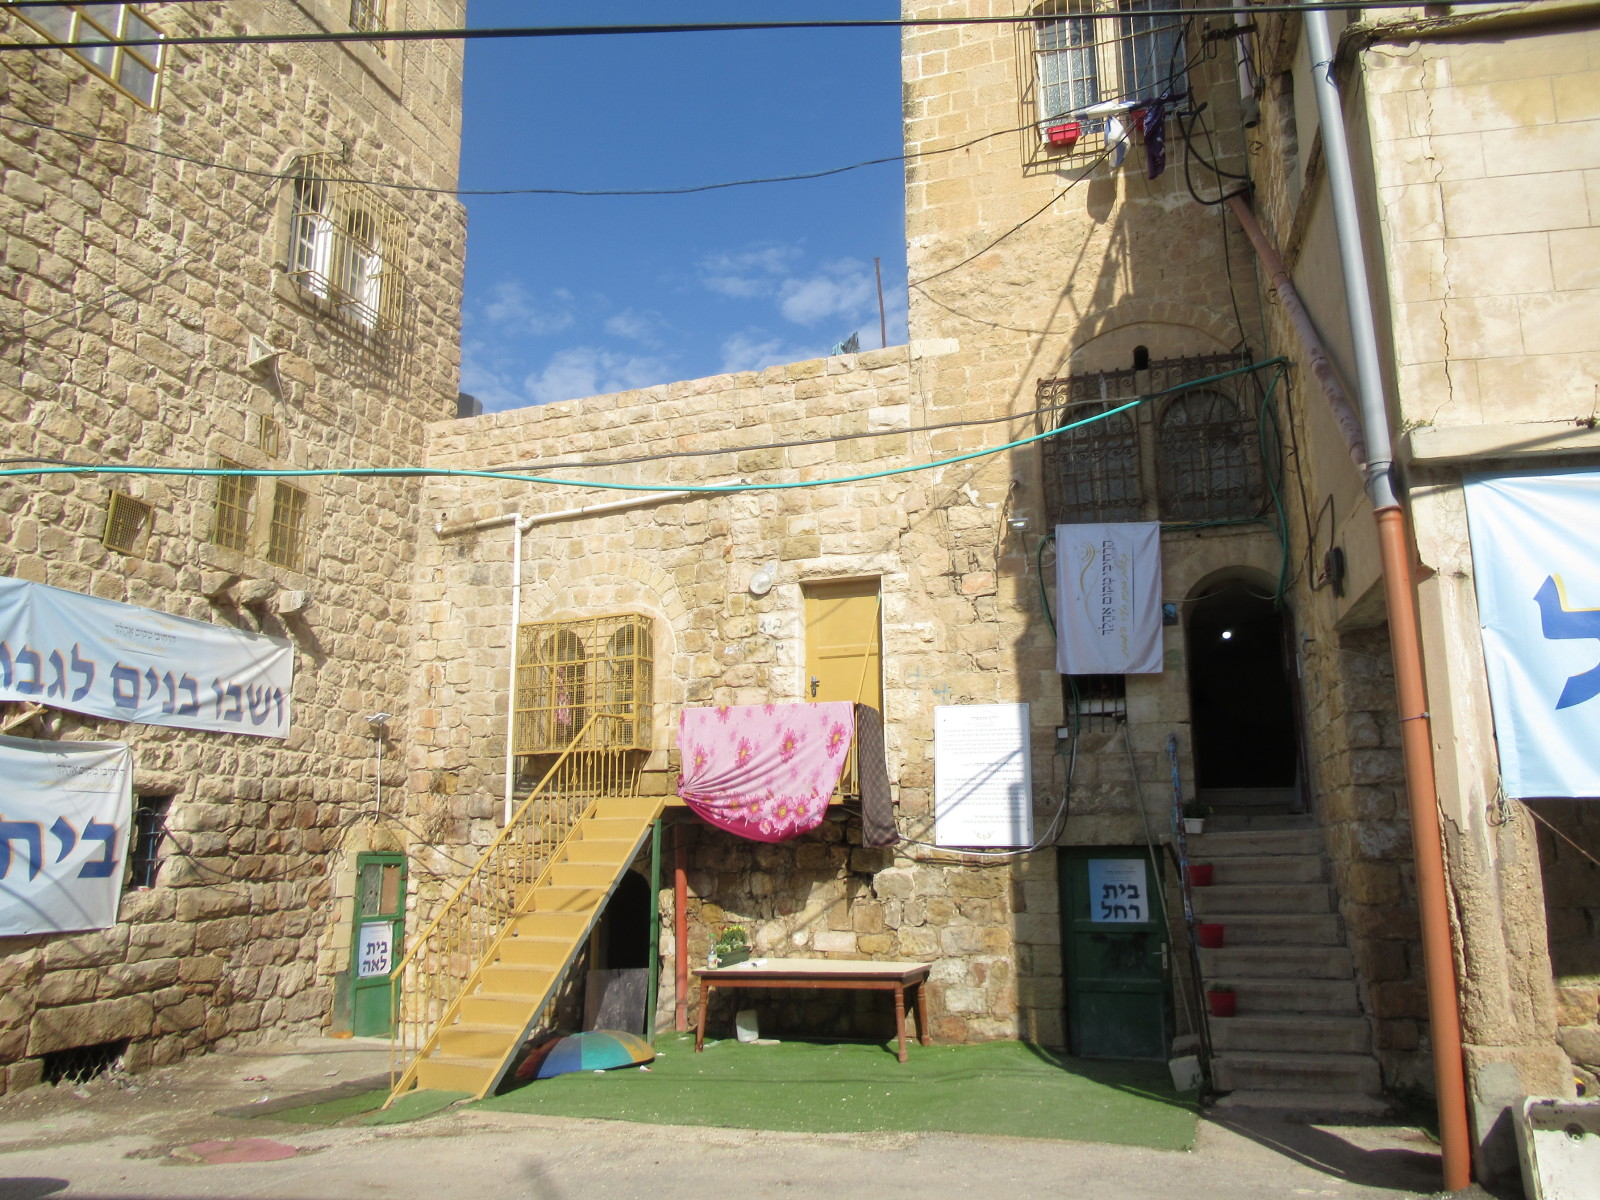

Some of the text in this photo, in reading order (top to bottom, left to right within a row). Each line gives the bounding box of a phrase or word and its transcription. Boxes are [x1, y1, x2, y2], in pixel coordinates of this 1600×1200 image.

[110, 660, 201, 717] בנים
[211, 677, 285, 729] ושבו
[0, 812, 121, 884] בית
[1102, 882, 1140, 900] בית
[1101, 900, 1141, 920] רחל
[366, 941, 388, 955] בית
[362, 955, 388, 973] לאה
